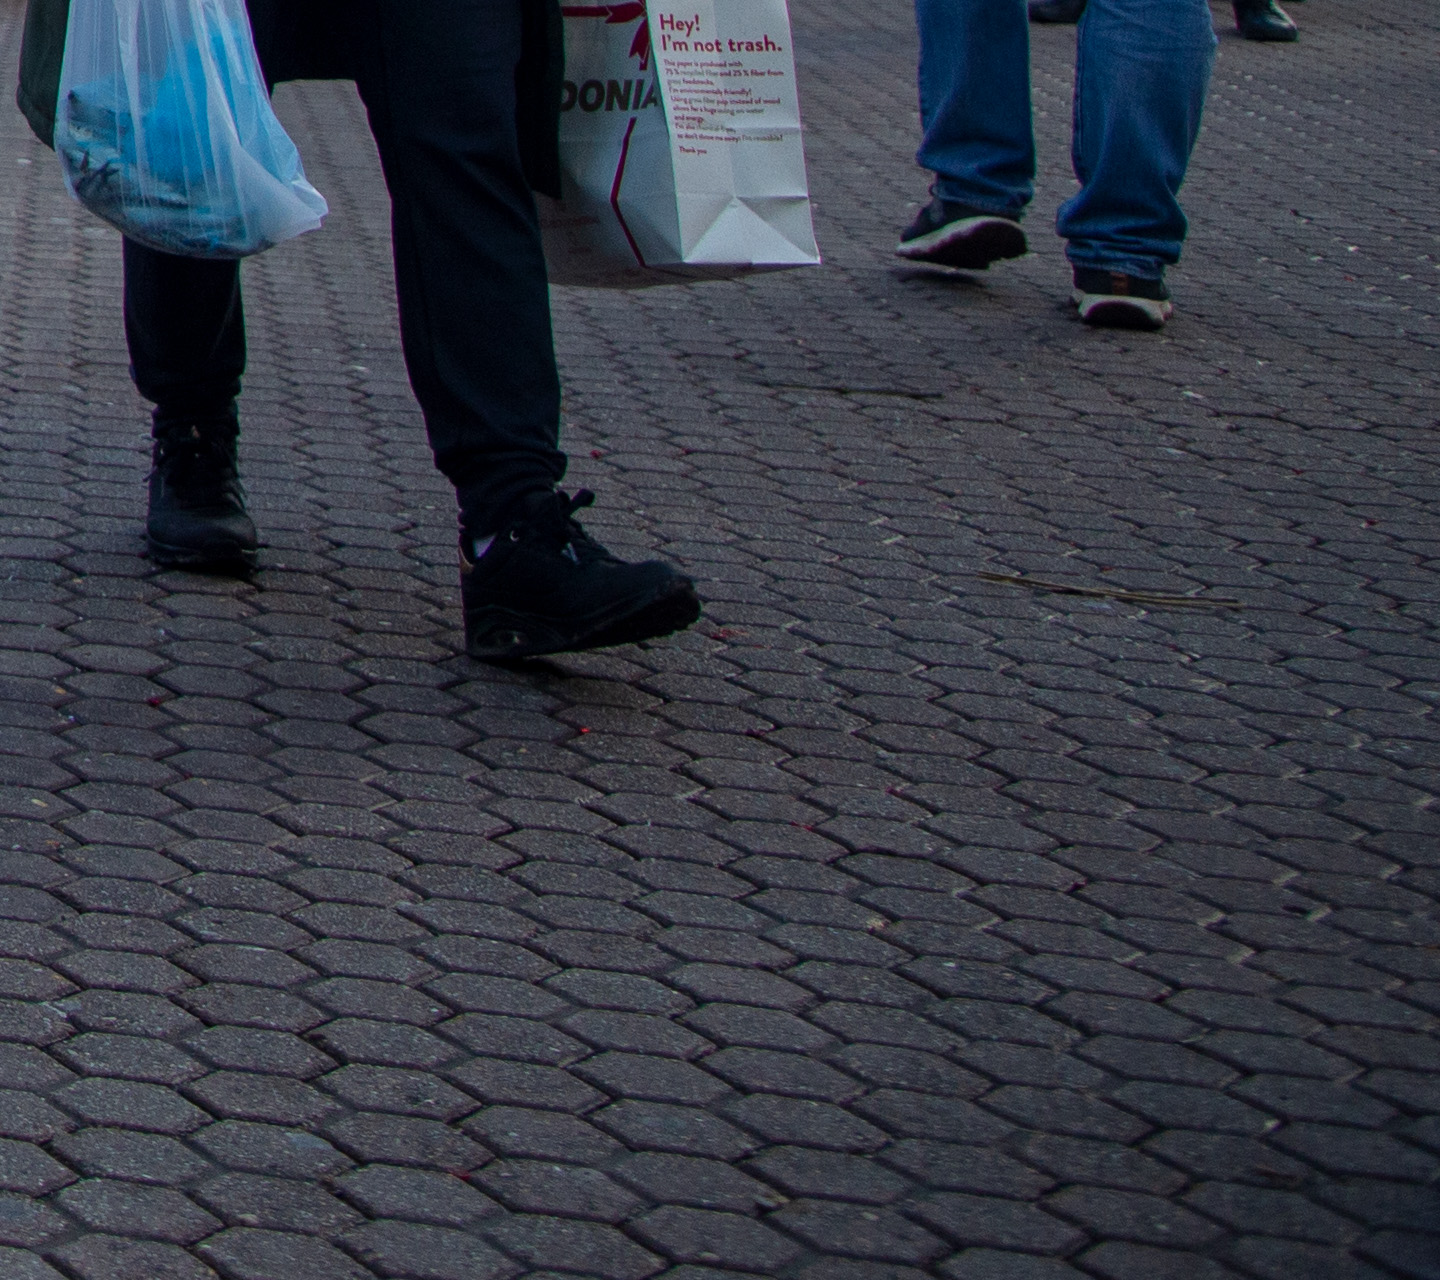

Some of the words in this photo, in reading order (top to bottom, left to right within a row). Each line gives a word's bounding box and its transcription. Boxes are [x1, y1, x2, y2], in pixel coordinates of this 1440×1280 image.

[659, 13, 700, 38] Hey!
[661, 34, 688, 52] I'm
[693, 39, 722, 52] not
[728, 34, 783, 52] trash.
